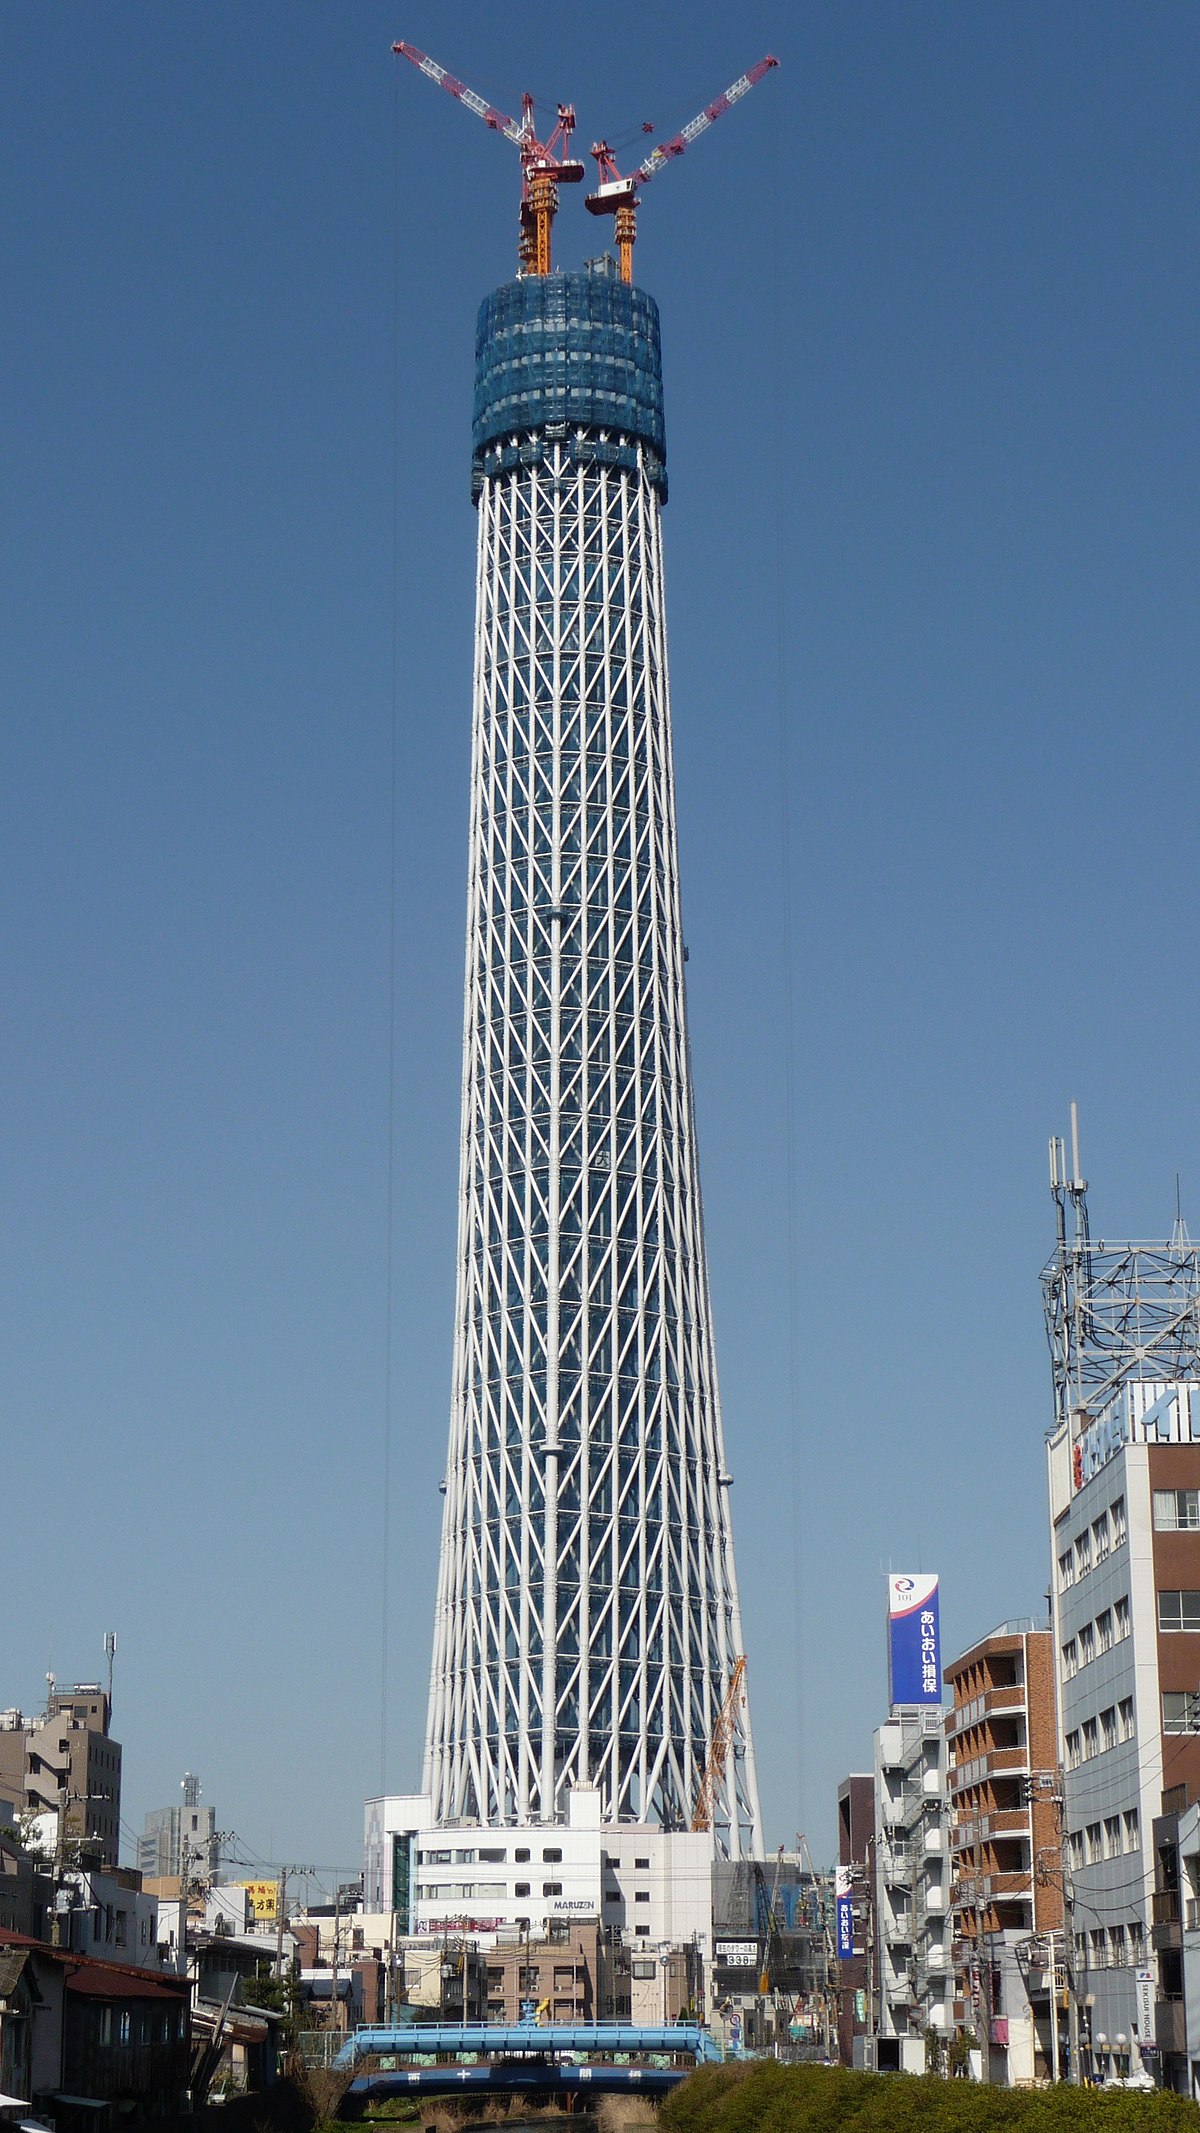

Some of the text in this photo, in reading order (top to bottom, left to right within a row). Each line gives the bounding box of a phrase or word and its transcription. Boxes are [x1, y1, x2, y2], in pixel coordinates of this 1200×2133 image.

[920, 1611, 937, 1693] あいおい損保
[554, 1901, 594, 1909] MARUZEN
[1142, 1984, 1150, 2011] SEKISUI
[1143, 2014, 1151, 2039] HOUSE
